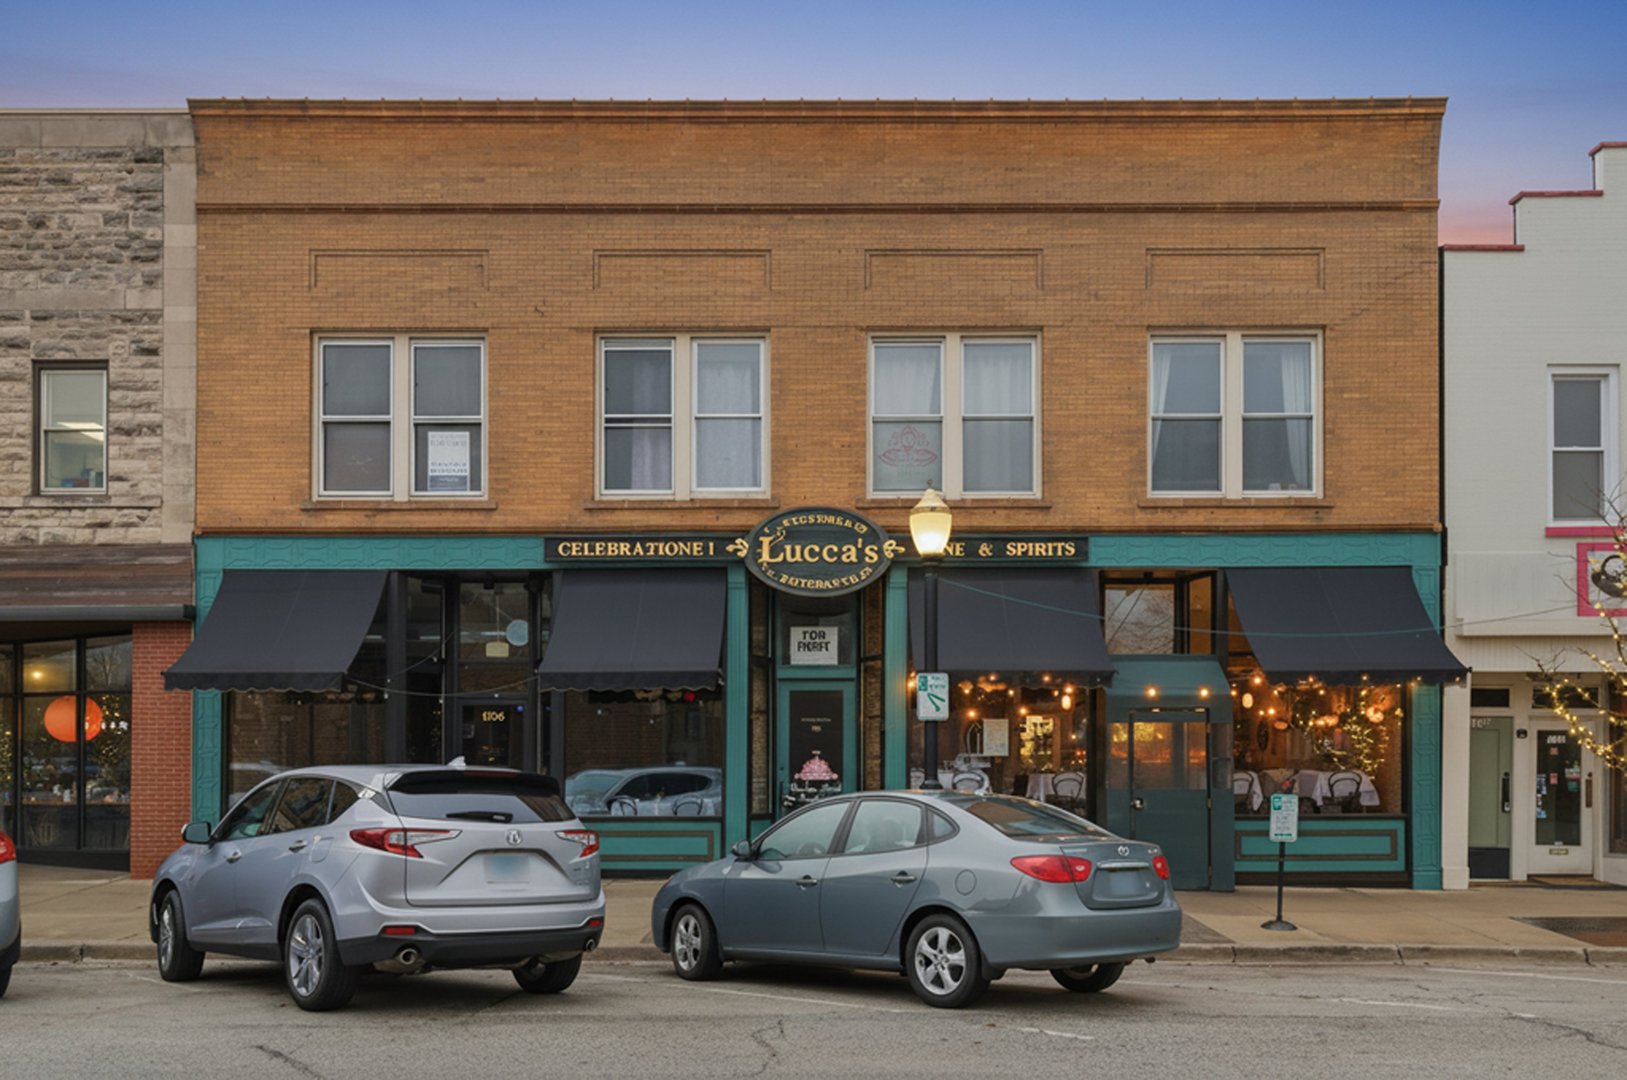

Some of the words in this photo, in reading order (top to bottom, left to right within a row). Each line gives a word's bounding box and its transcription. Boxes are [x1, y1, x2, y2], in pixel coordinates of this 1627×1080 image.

[757, 534, 879, 564] Lucca's
[978, 541, 994, 557] &
[1005, 541, 1076, 557] SPIRITS
